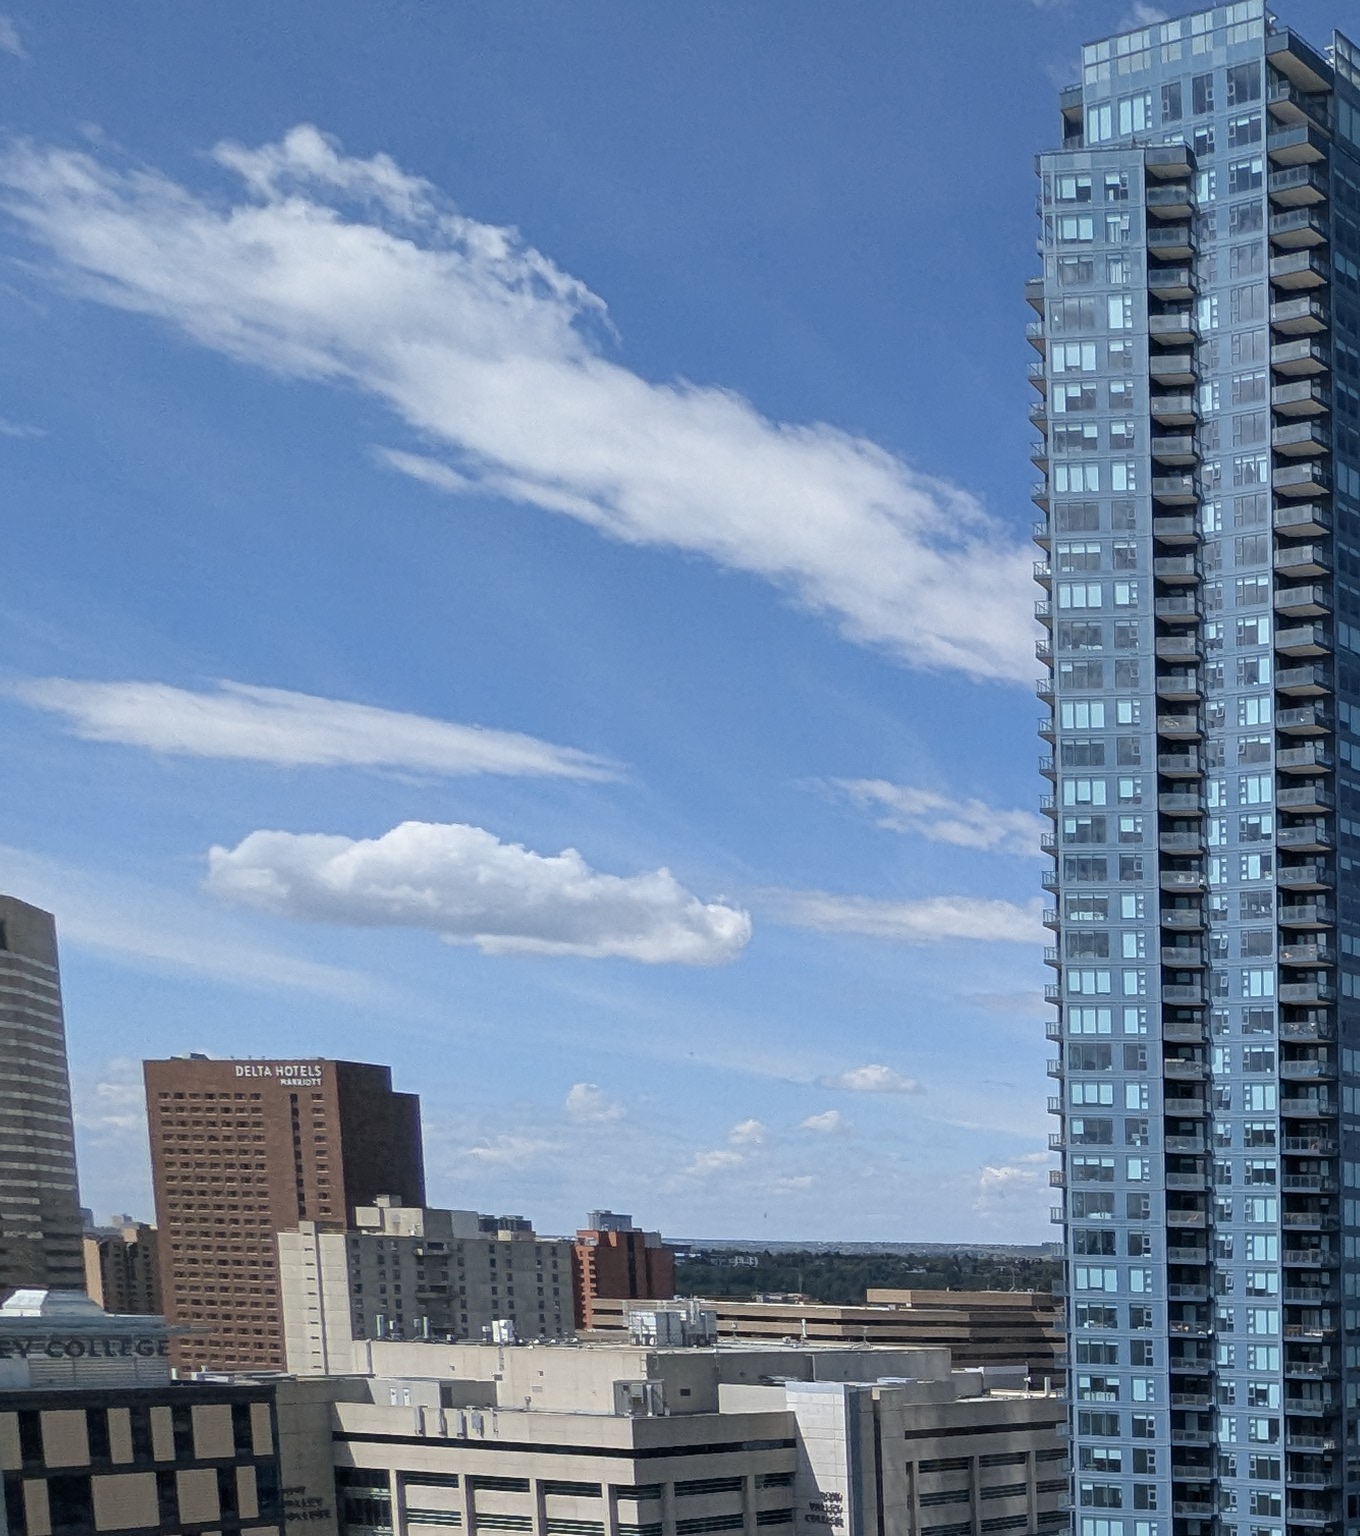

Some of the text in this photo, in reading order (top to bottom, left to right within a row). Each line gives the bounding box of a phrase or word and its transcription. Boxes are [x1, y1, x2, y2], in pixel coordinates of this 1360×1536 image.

[235, 1065, 322, 1078] DELTA HOTELS
[45, 1338, 170, 1358] COLLEGE
